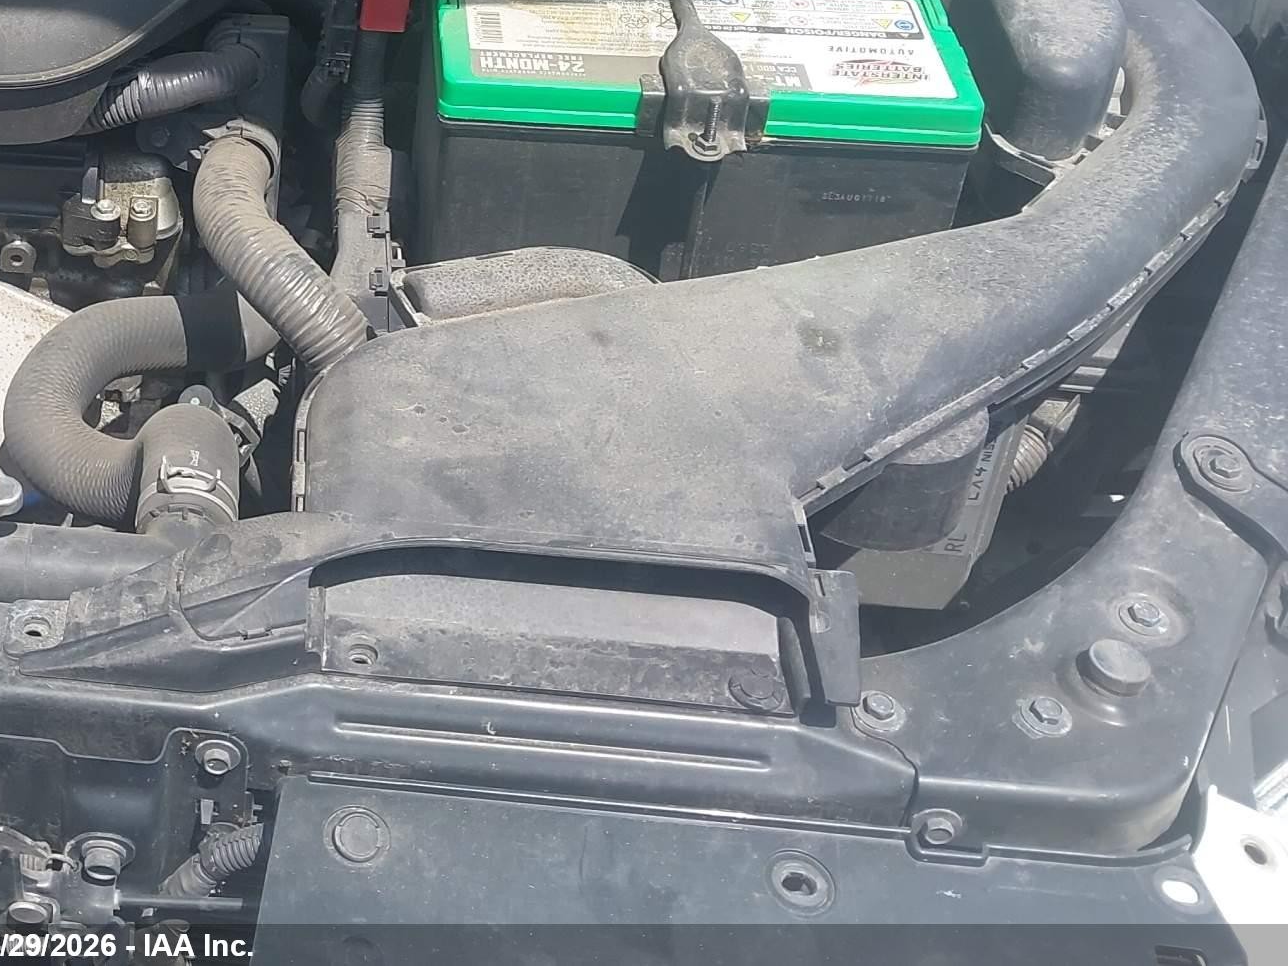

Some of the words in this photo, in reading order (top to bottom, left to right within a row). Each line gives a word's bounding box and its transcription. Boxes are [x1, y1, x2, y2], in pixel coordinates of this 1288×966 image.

[784, 27, 888, 38] DANGER/POISON
[827, 45, 915, 56] AUTOMOTIVE
[479, 56, 585, 73] 24-MONTH
[834, 63, 924, 73] BATTERIES
[831, 70, 930, 82] INTERSTATE
[943, 532, 968, 553] RL
